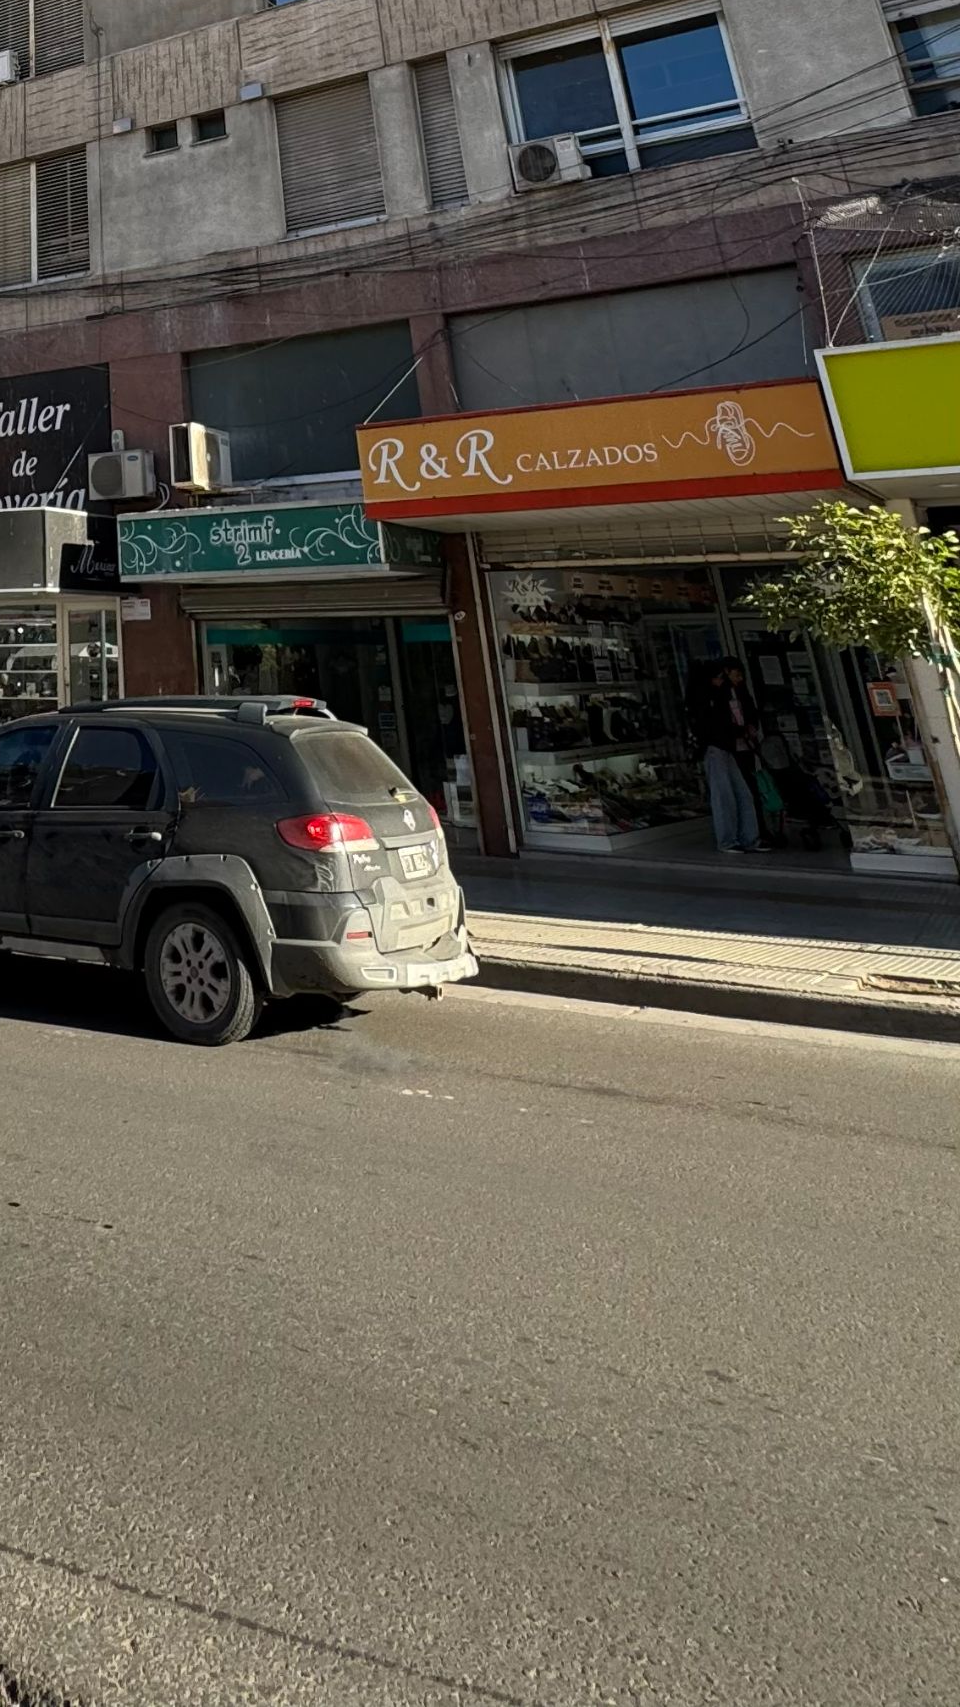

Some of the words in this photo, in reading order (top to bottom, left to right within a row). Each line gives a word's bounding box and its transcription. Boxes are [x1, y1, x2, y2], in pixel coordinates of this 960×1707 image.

[12, 450, 38, 478] de
[369, 437, 421, 492] R
[419, 443, 451, 480] &
[456, 429, 513, 485] R
[516, 443, 658, 473] CALZADOS
[234, 543, 252, 565] 2
[255, 547, 302, 562] LENCERÍA
